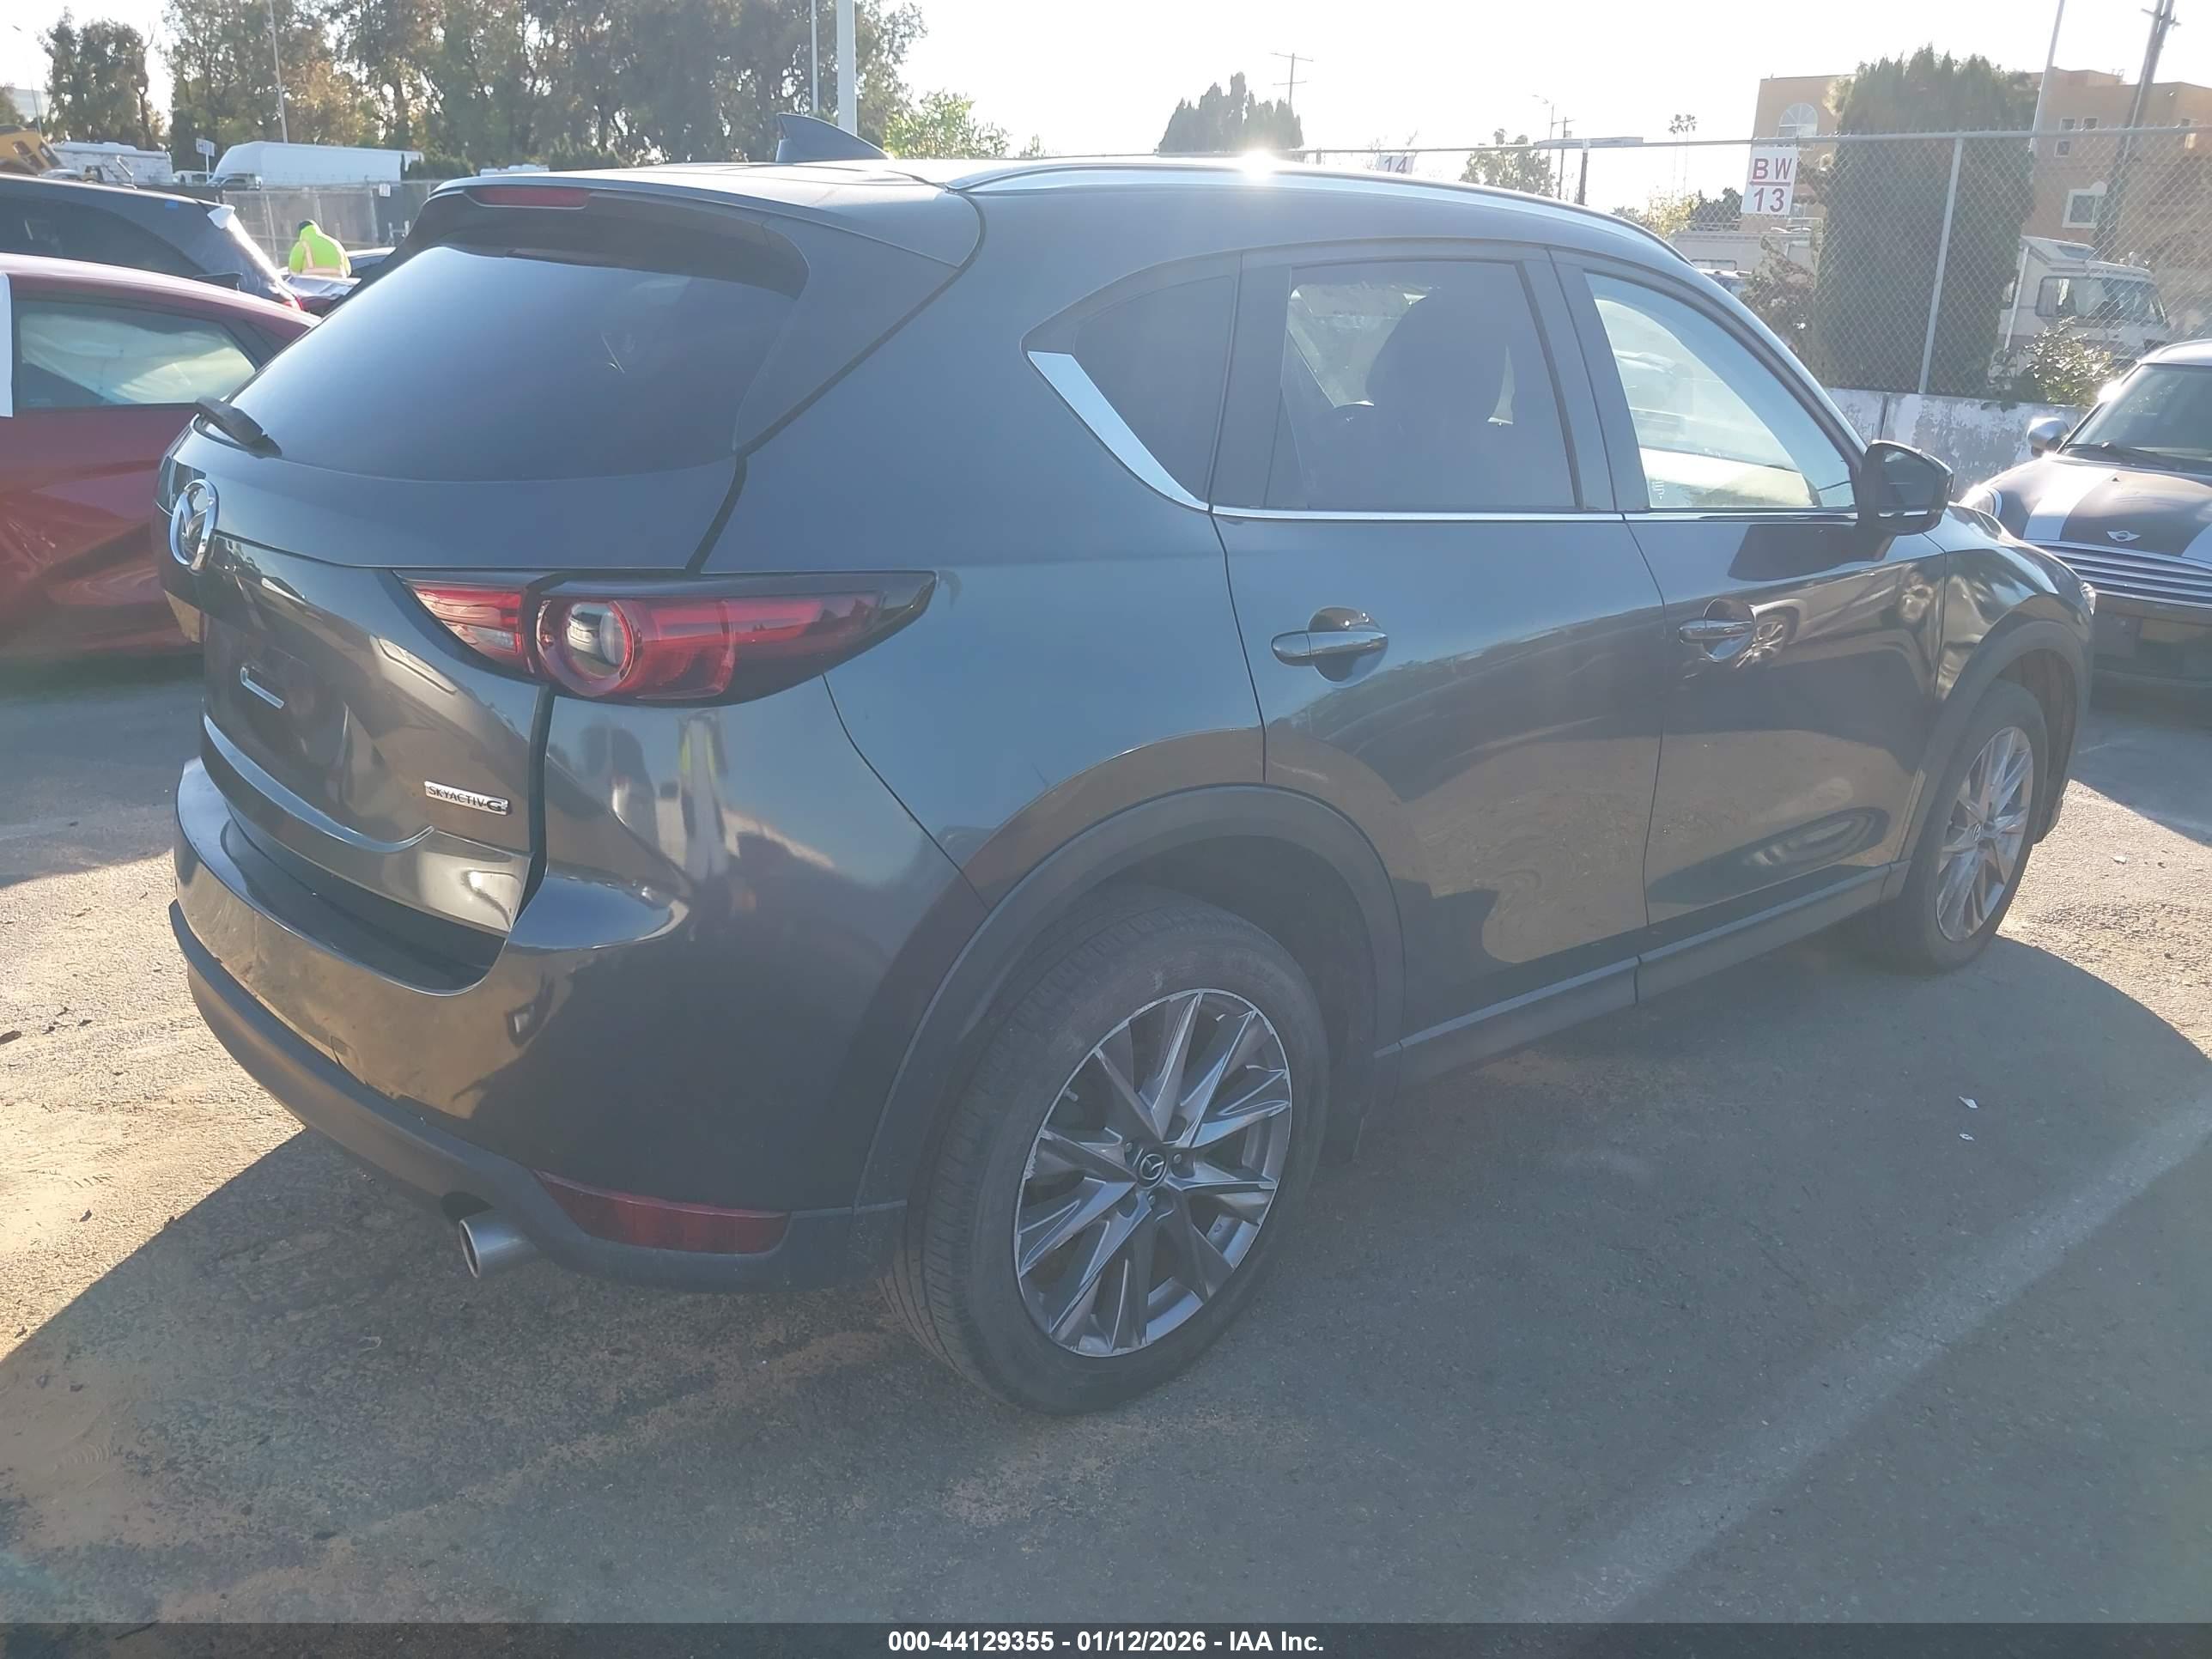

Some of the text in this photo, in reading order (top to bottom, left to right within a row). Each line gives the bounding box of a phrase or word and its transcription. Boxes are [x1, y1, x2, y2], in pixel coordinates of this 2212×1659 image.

[1384, 155, 1407, 173] 14
[1752, 158, 1792, 179] BW
[1753, 187, 1784, 212] 13
